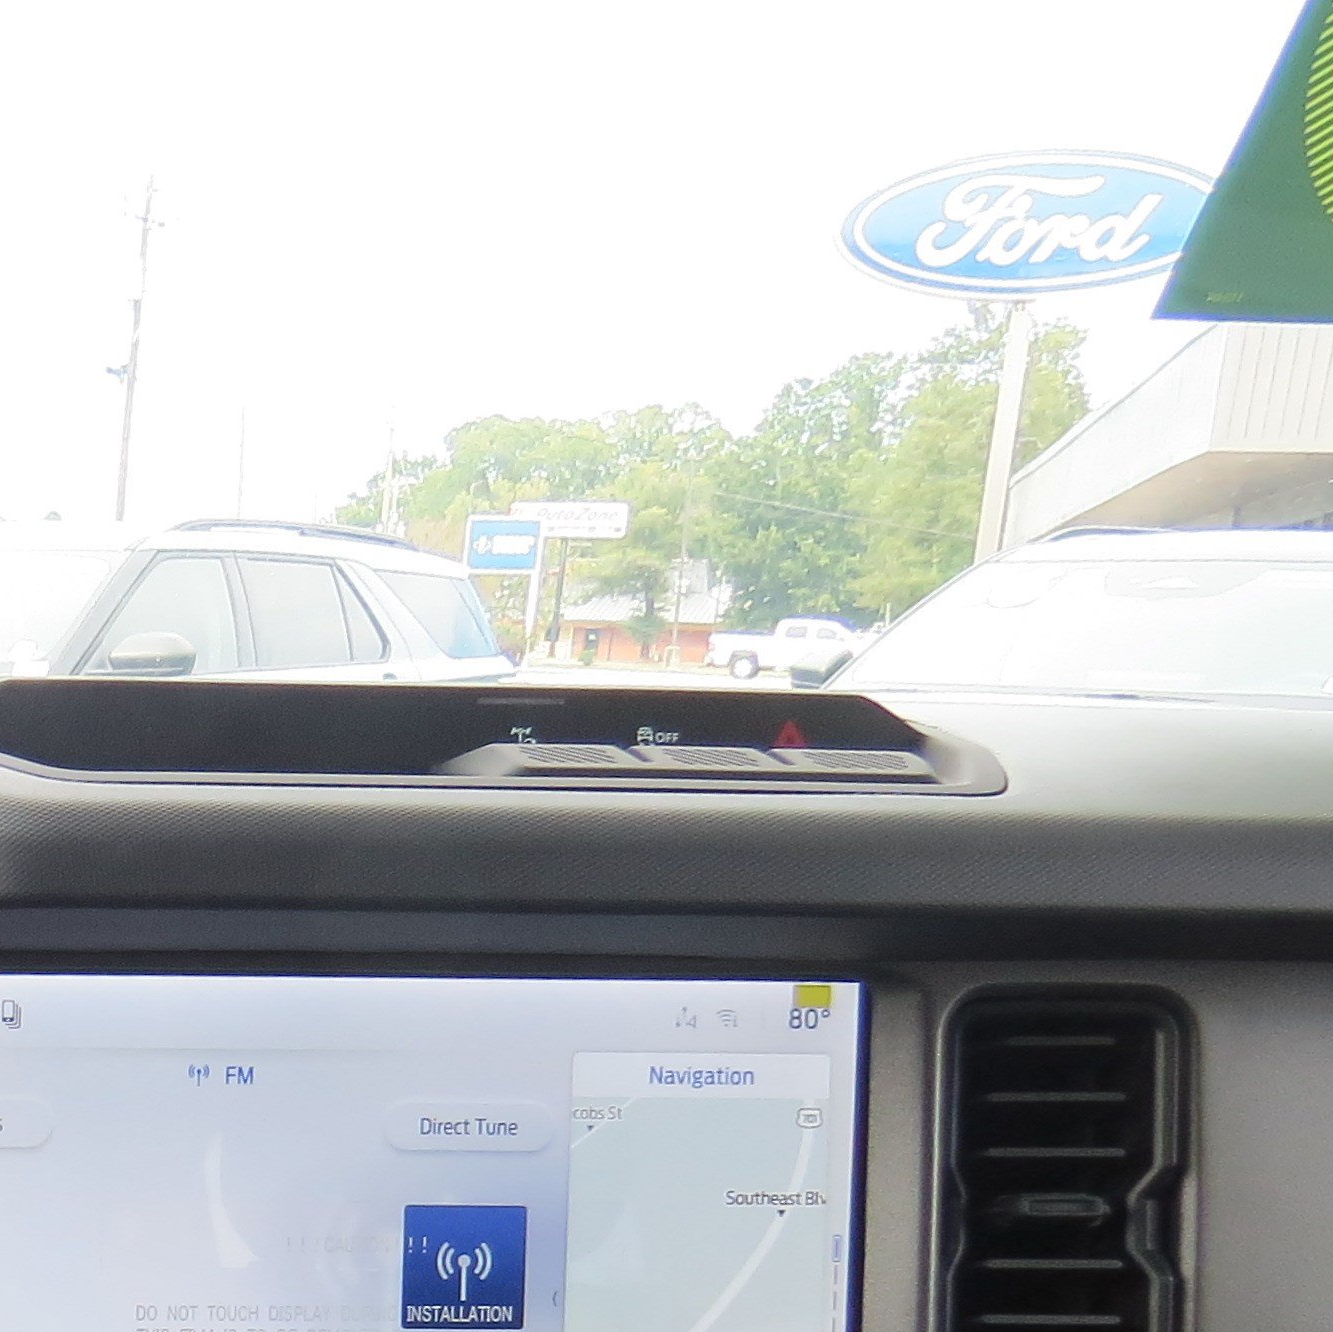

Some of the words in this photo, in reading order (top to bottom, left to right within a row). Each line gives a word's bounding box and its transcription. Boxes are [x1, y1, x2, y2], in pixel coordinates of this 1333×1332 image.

[915, 174, 1165, 267] Ford
[654, 731, 679, 745] OFF
[788, 1008, 831, 1031] 80°
[225, 1066, 255, 1085] FM
[649, 1066, 754, 1088] Navigation
[572, 1106, 605, 1120] cobs
[419, 1118, 471, 1136] Direct
[474, 1118, 519, 1136] Tune
[725, 1191, 802, 1206] Southeast
[136, 1305, 158, 1322] DO
[167, 1305, 198, 1322] NOT
[208, 1305, 259, 1322] TOUCH
[268, 1305, 331, 1322] DISPLAY
[406, 1305, 513, 1323] INSTALLATION
